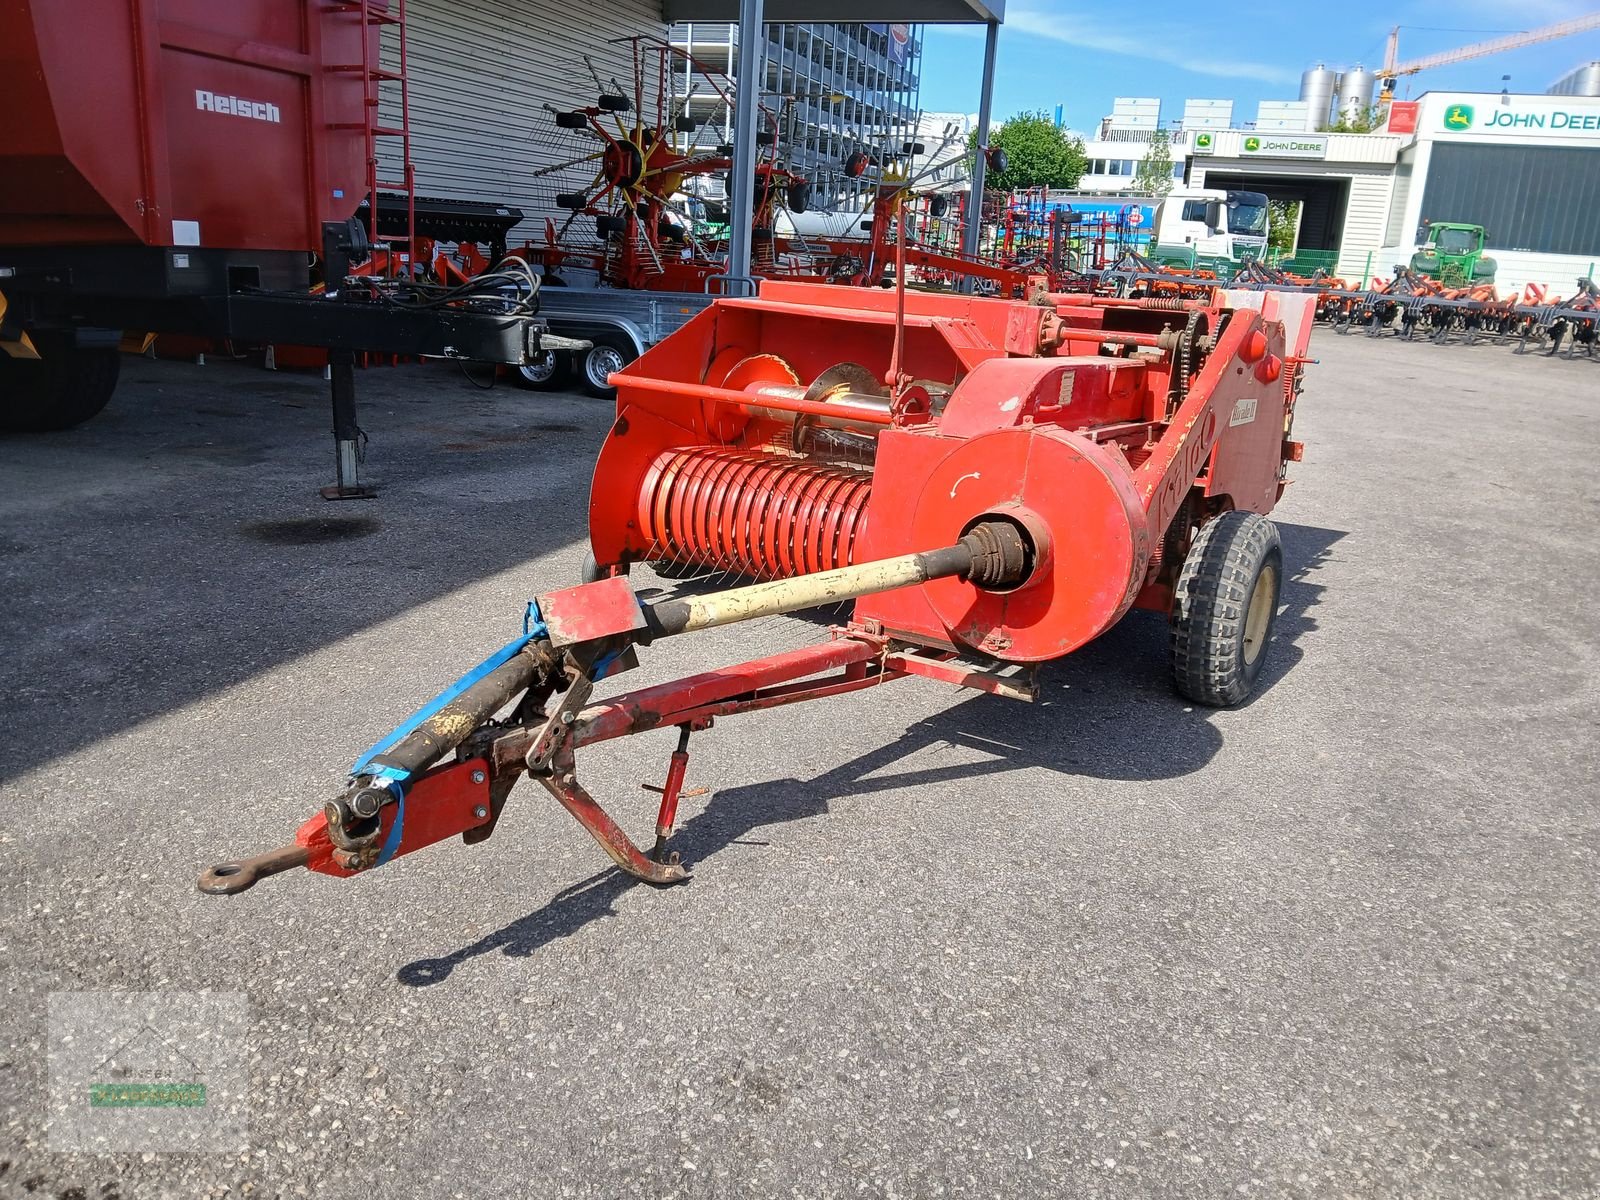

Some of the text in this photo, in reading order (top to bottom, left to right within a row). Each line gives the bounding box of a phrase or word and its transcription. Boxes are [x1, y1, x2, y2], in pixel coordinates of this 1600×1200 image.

[195, 89, 280, 123] Reisch
[1484, 110, 1600, 130] JOHN DEE
[1263, 141, 1322, 151] JOHN DEERE
